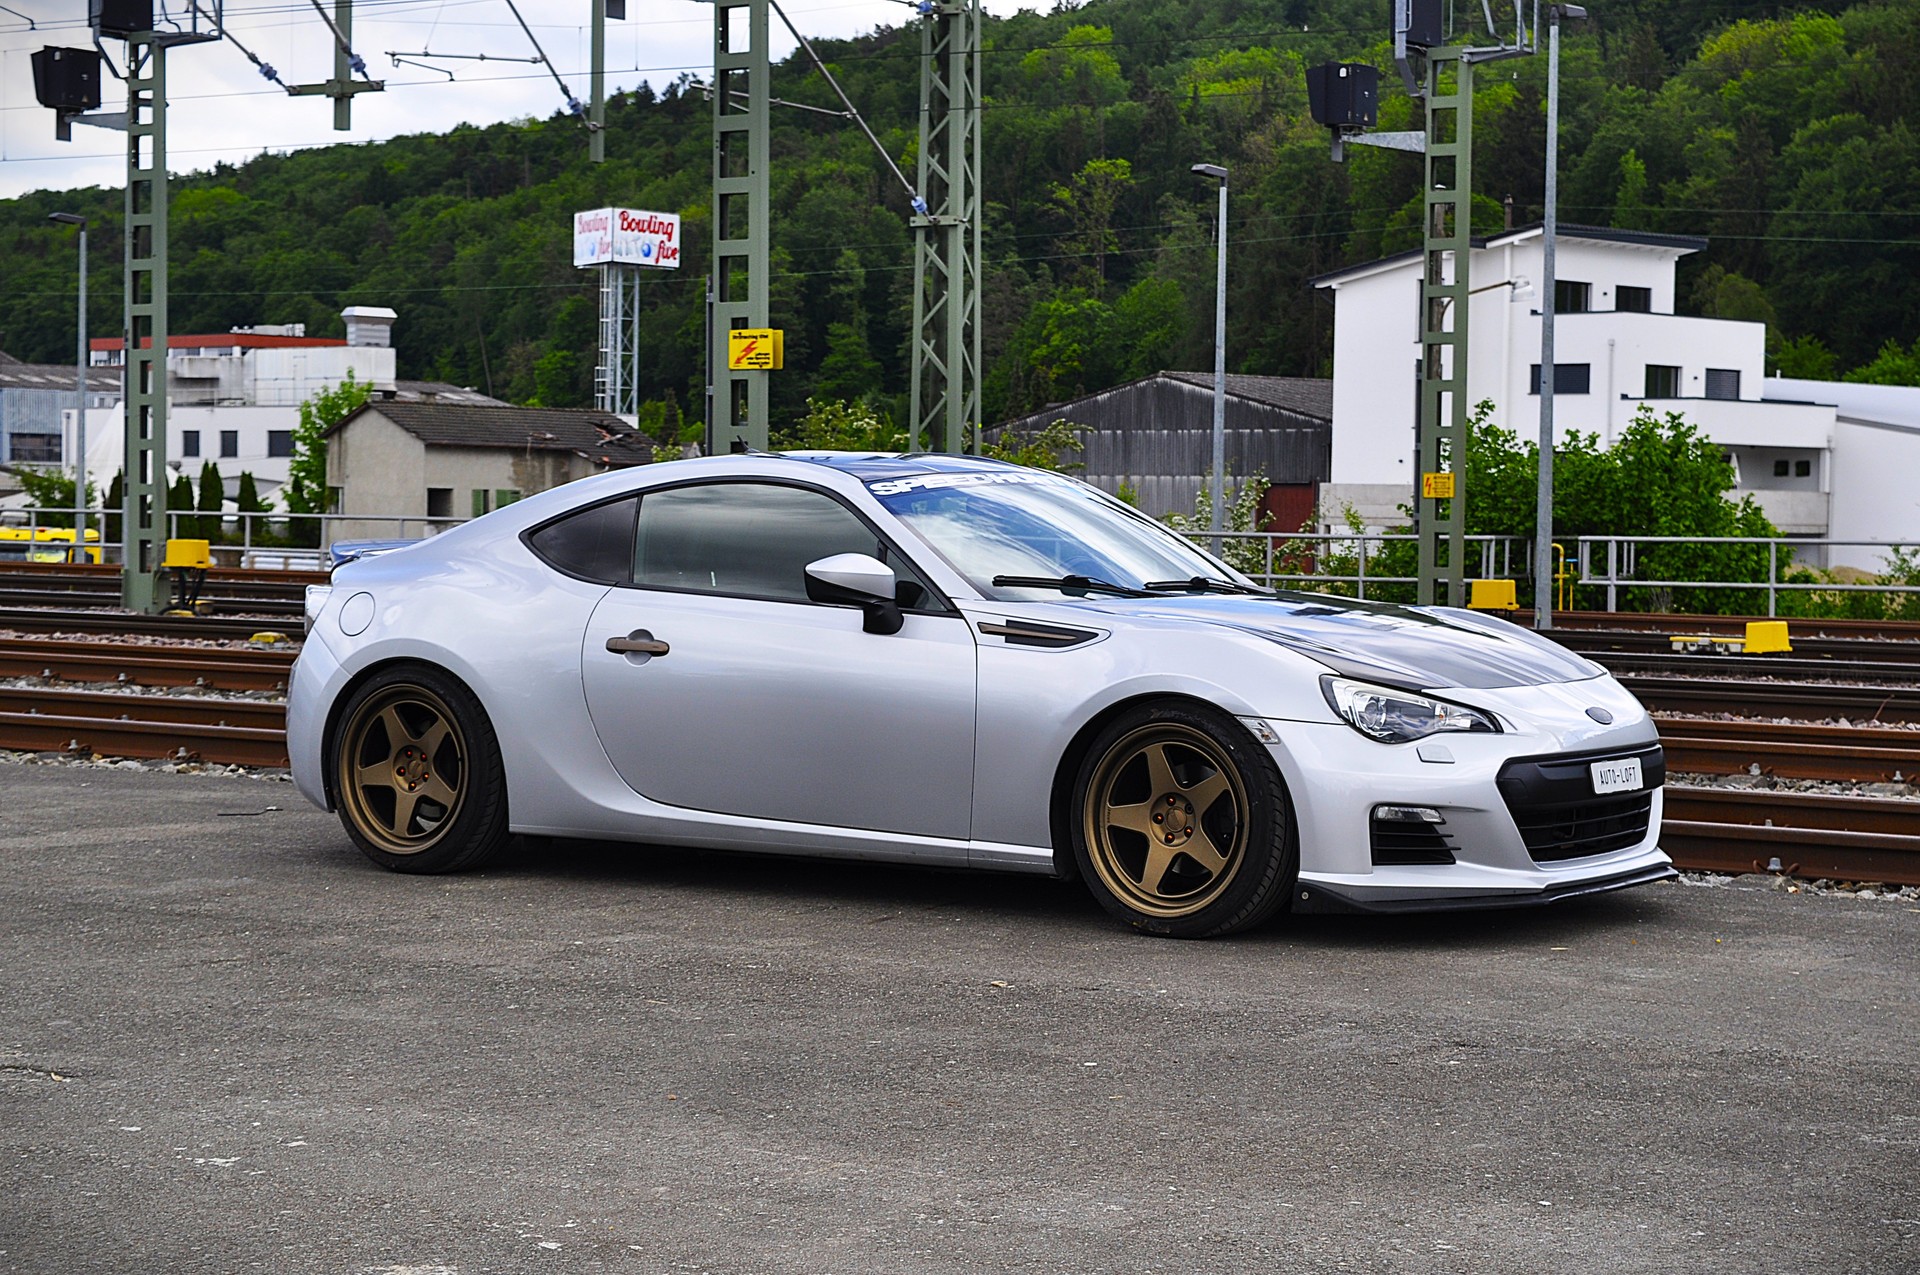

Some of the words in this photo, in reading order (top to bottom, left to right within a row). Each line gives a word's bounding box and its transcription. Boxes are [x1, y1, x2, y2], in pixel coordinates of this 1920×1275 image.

[619, 210, 674, 242] Bowling
[655, 240, 680, 264] five
[1599, 766, 1637, 786] AUTO-LOFT
